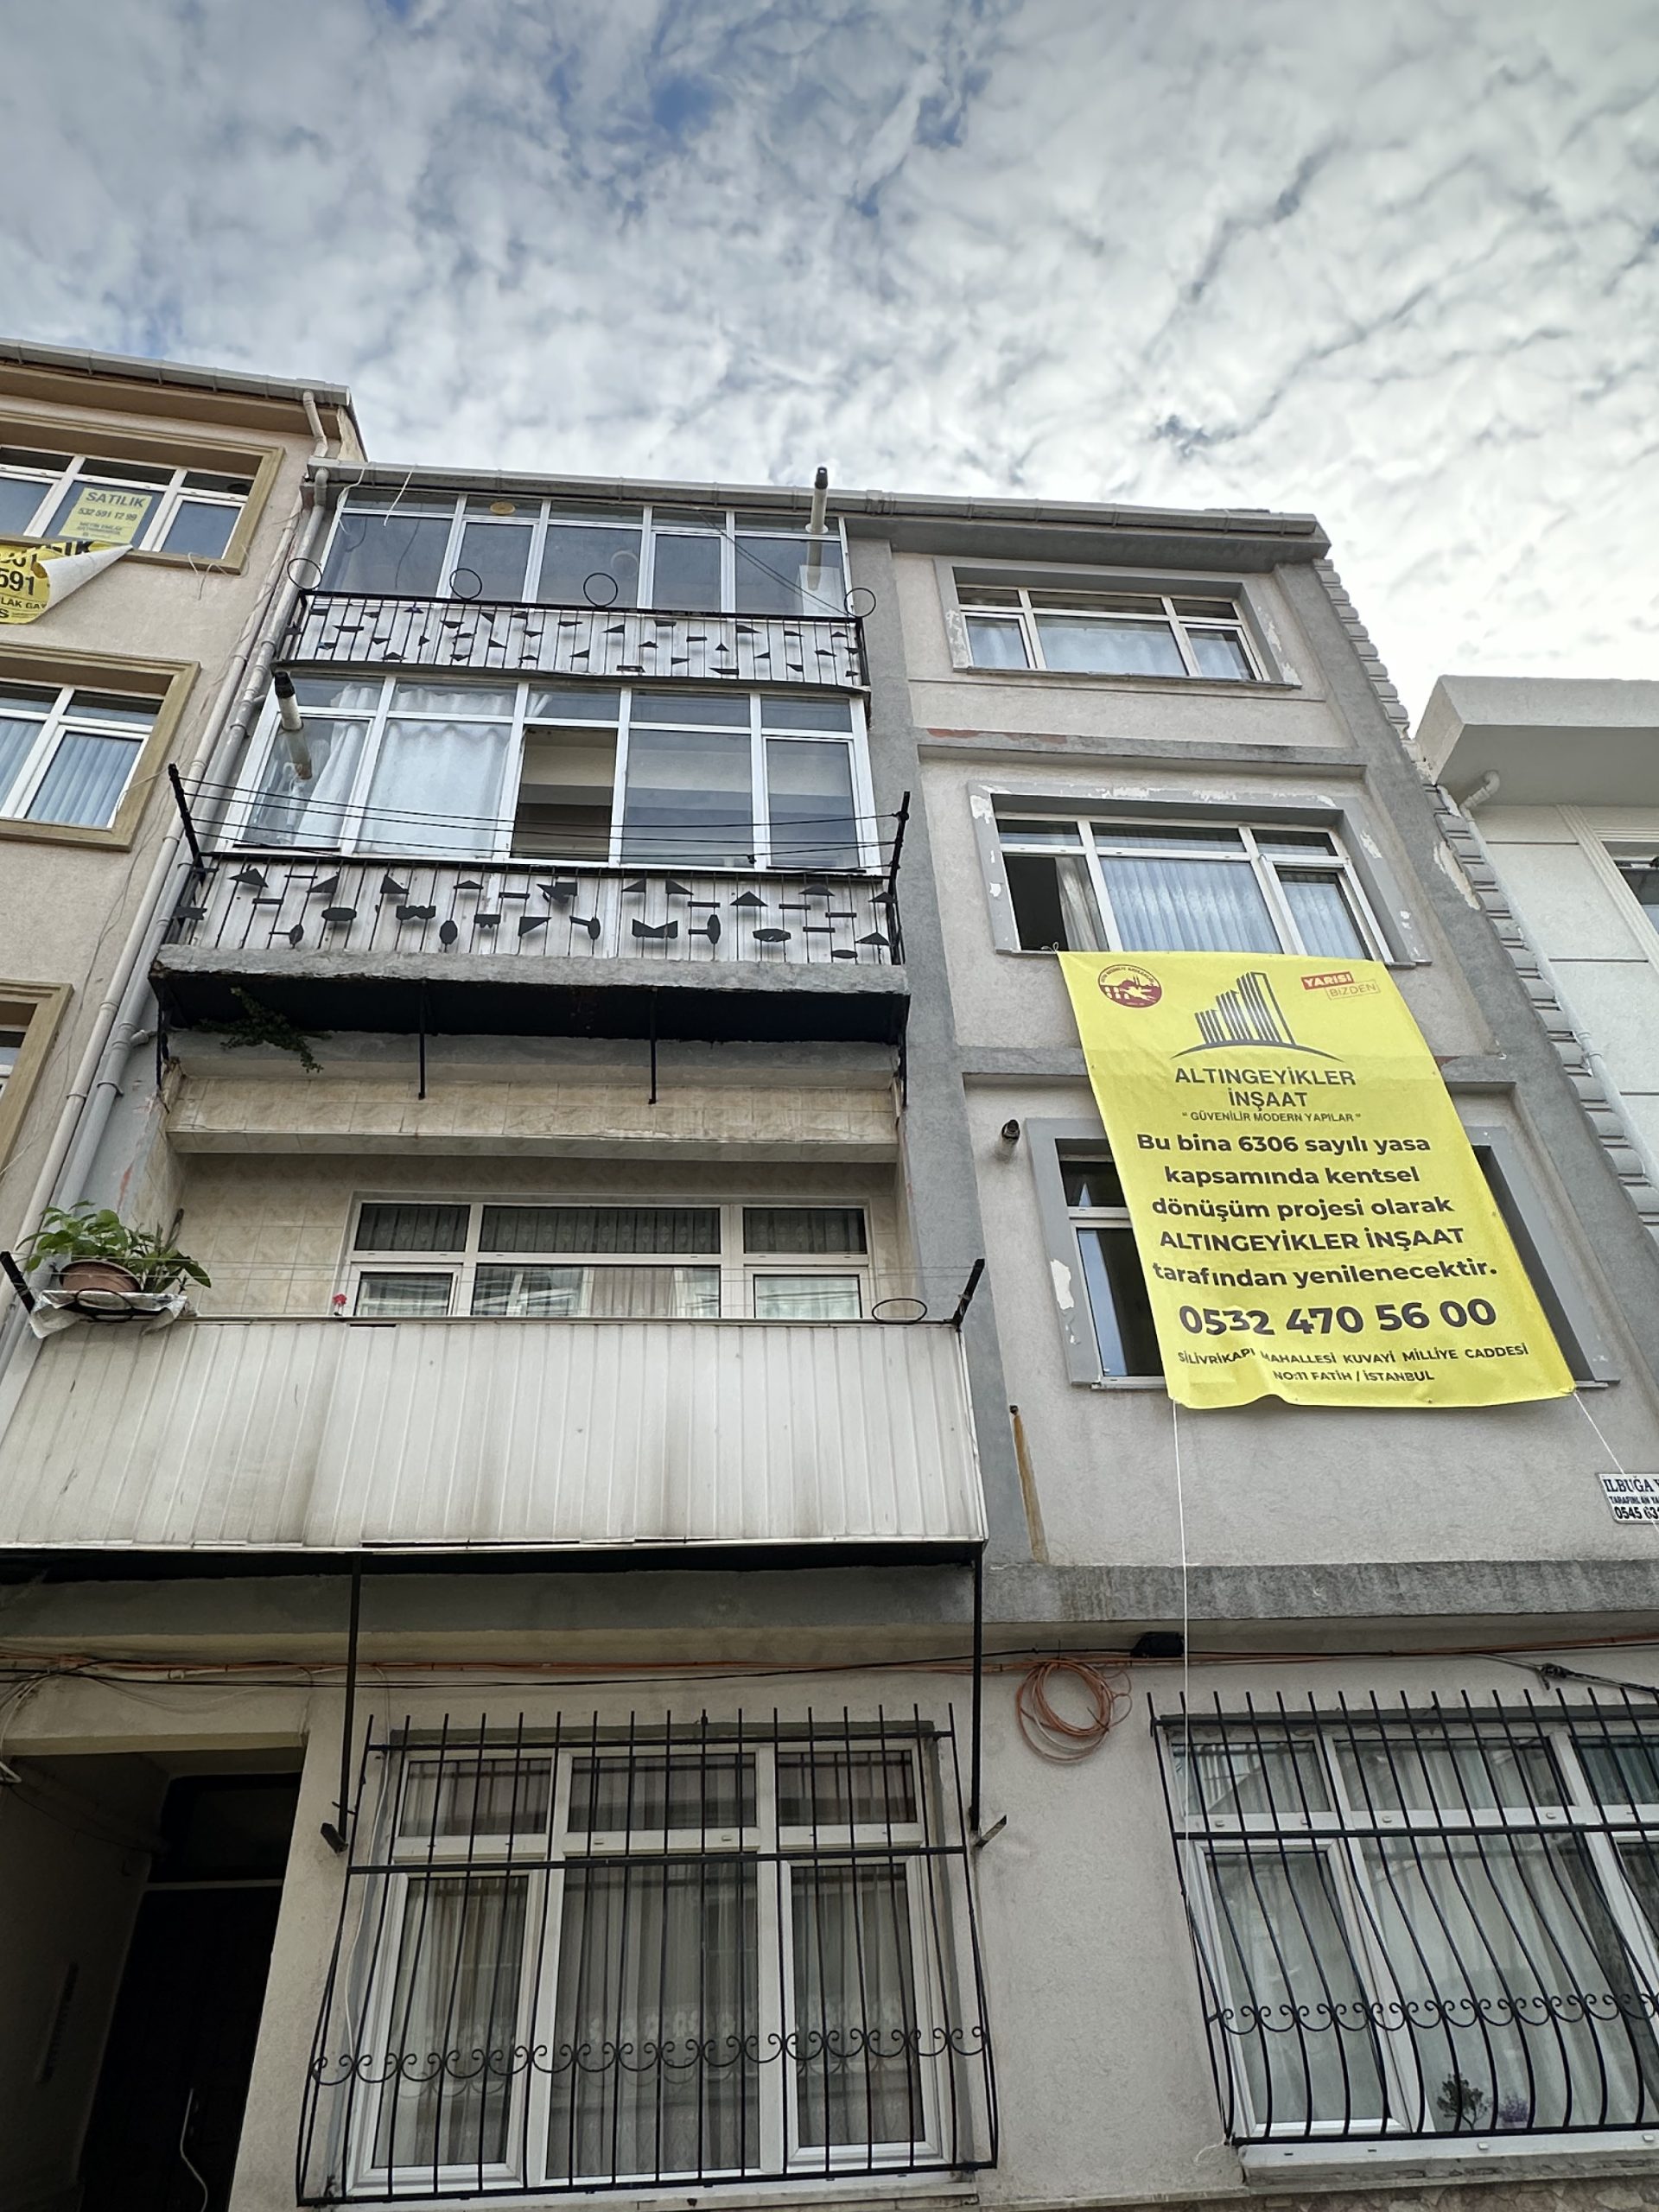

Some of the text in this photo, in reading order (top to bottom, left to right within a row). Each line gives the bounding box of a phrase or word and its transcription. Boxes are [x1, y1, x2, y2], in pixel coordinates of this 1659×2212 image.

[86, 492, 145, 507] SATILIK
[1303, 973, 1352, 987] YARISI
[1175, 1066, 1357, 1086] ALTINGEYİKLER
[1228, 1087, 1308, 1112] İNŞAAT
[1190, 1109, 1250, 1122] GÜVENİLİR
[1253, 1113, 1302, 1122] MODERN
[1303, 1113, 1354, 1122] YAPILAR
[1137, 1134, 1431, 1156] Bu bina 6306 sayılı yasa
[1165, 1166, 1420, 1188] kapsamında kentsel
[1152, 1196, 1454, 1223] dönüşüm projesi olarak
[1160, 1227, 1465, 1252] ALTINGEYİKLER İNŞAAT
[1153, 1258, 1497, 1289] tarafından yenilenecektir.
[1179, 1298, 1497, 1336] 0532 470 56 00
[1178, 1347, 1255, 1364] SİLİVRİKAPI
[1343, 1350, 1396, 1364] KUVAYİ
[1402, 1346, 1459, 1362] MİLLİYE
[1465, 1342, 1529, 1359] CADDESİ
[1311, 1370, 1353, 1381] FATİH
[1363, 1370, 1435, 1382] İSTANBUL
[1613, 1506, 1643, 1519] 0545
